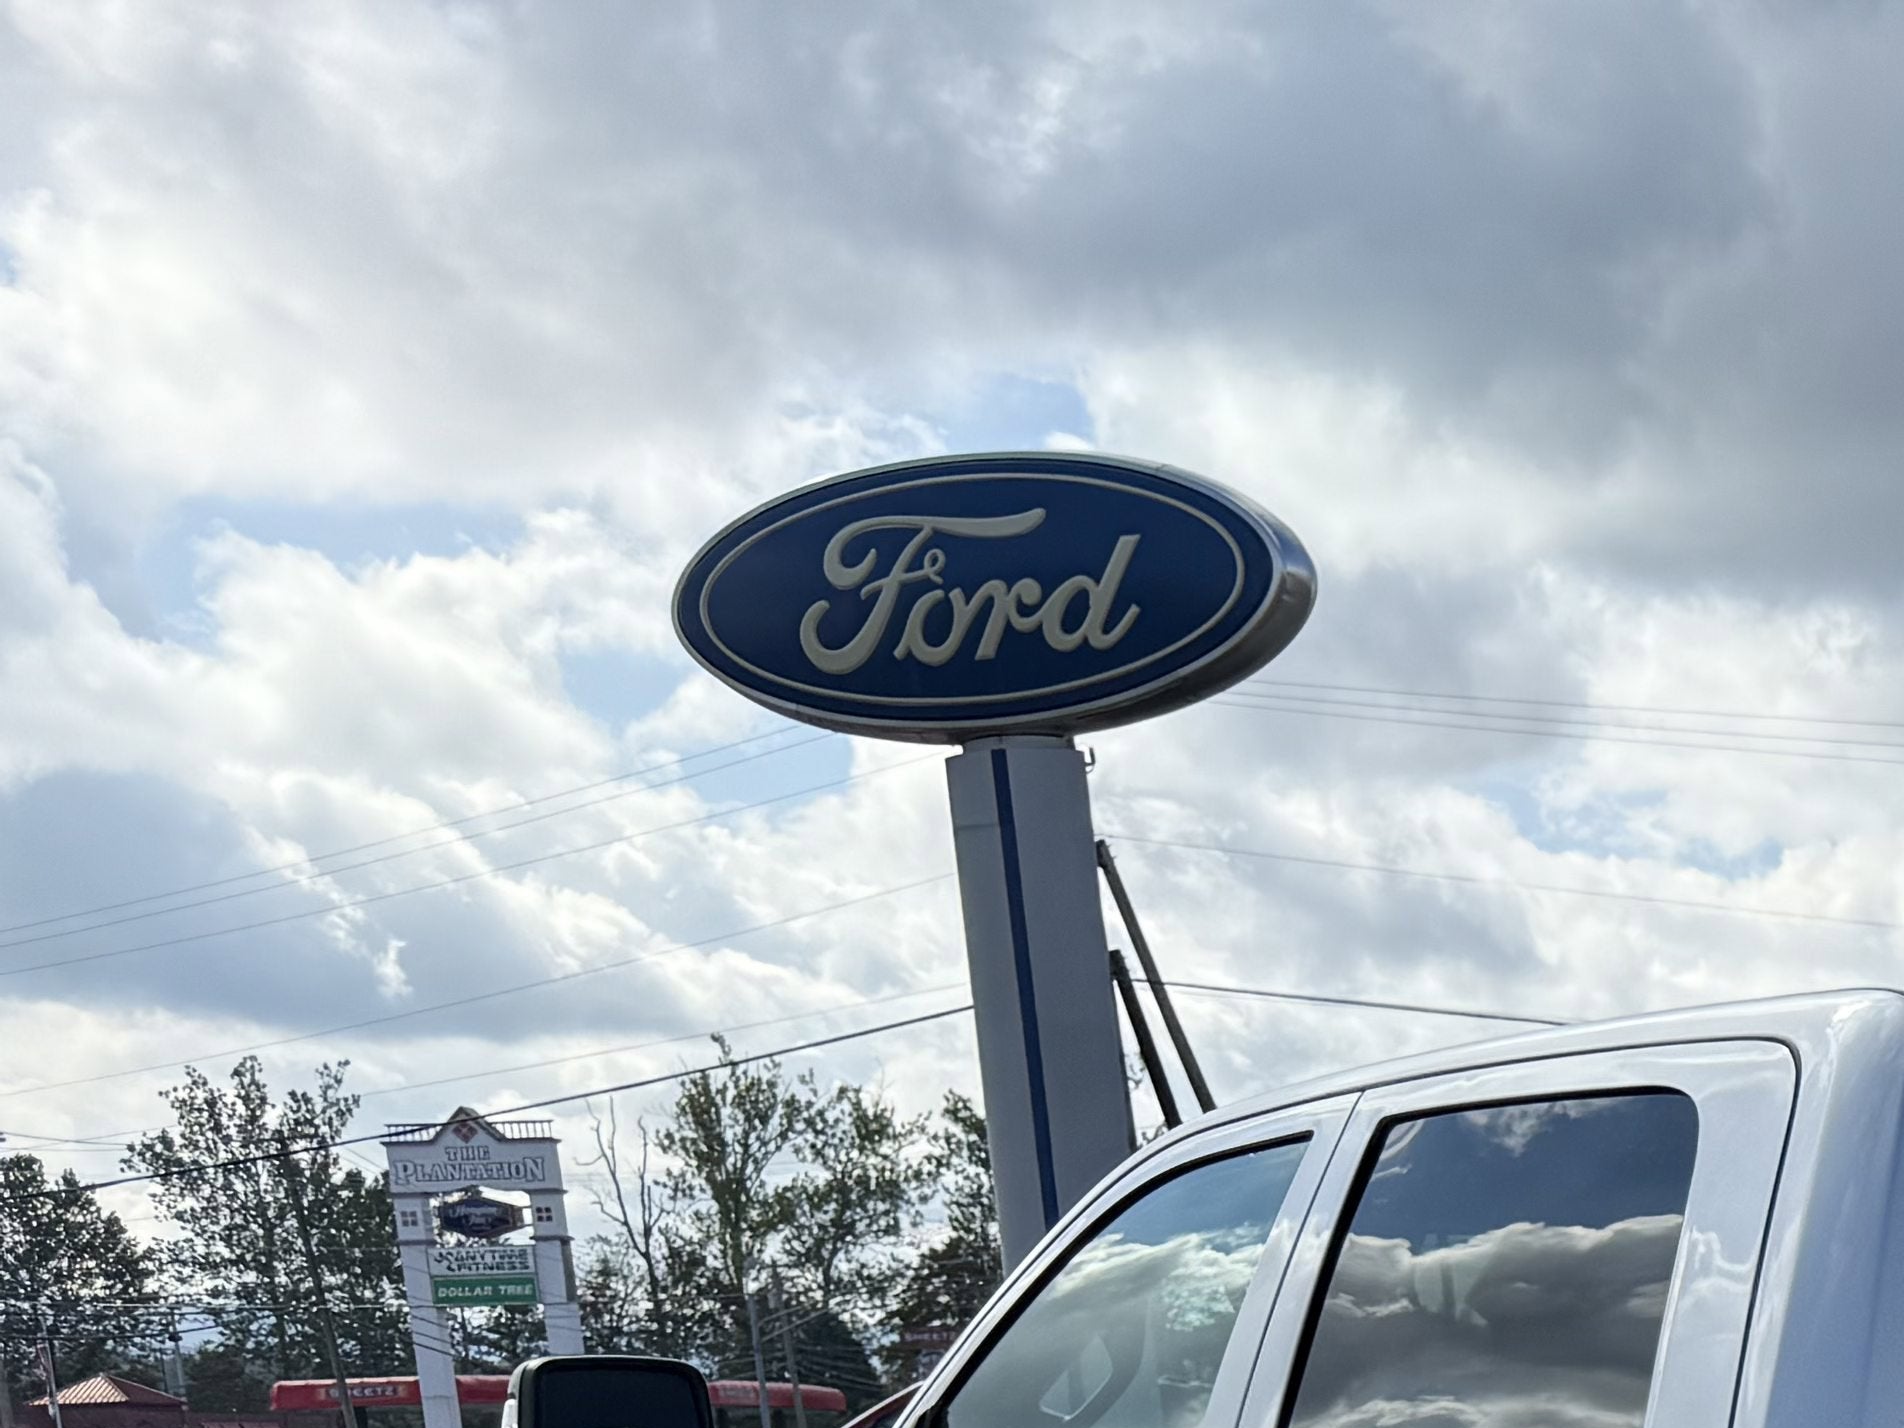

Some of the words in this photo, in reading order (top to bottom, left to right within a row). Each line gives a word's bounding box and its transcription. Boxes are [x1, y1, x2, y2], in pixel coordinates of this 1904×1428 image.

[801, 507, 1140, 675] Ford
[445, 1145, 490, 1161] THE
[393, 1157, 545, 1186] PLANTATION
[438, 1286, 493, 1298] DOLLAR
[499, 1284, 533, 1296] TREE
